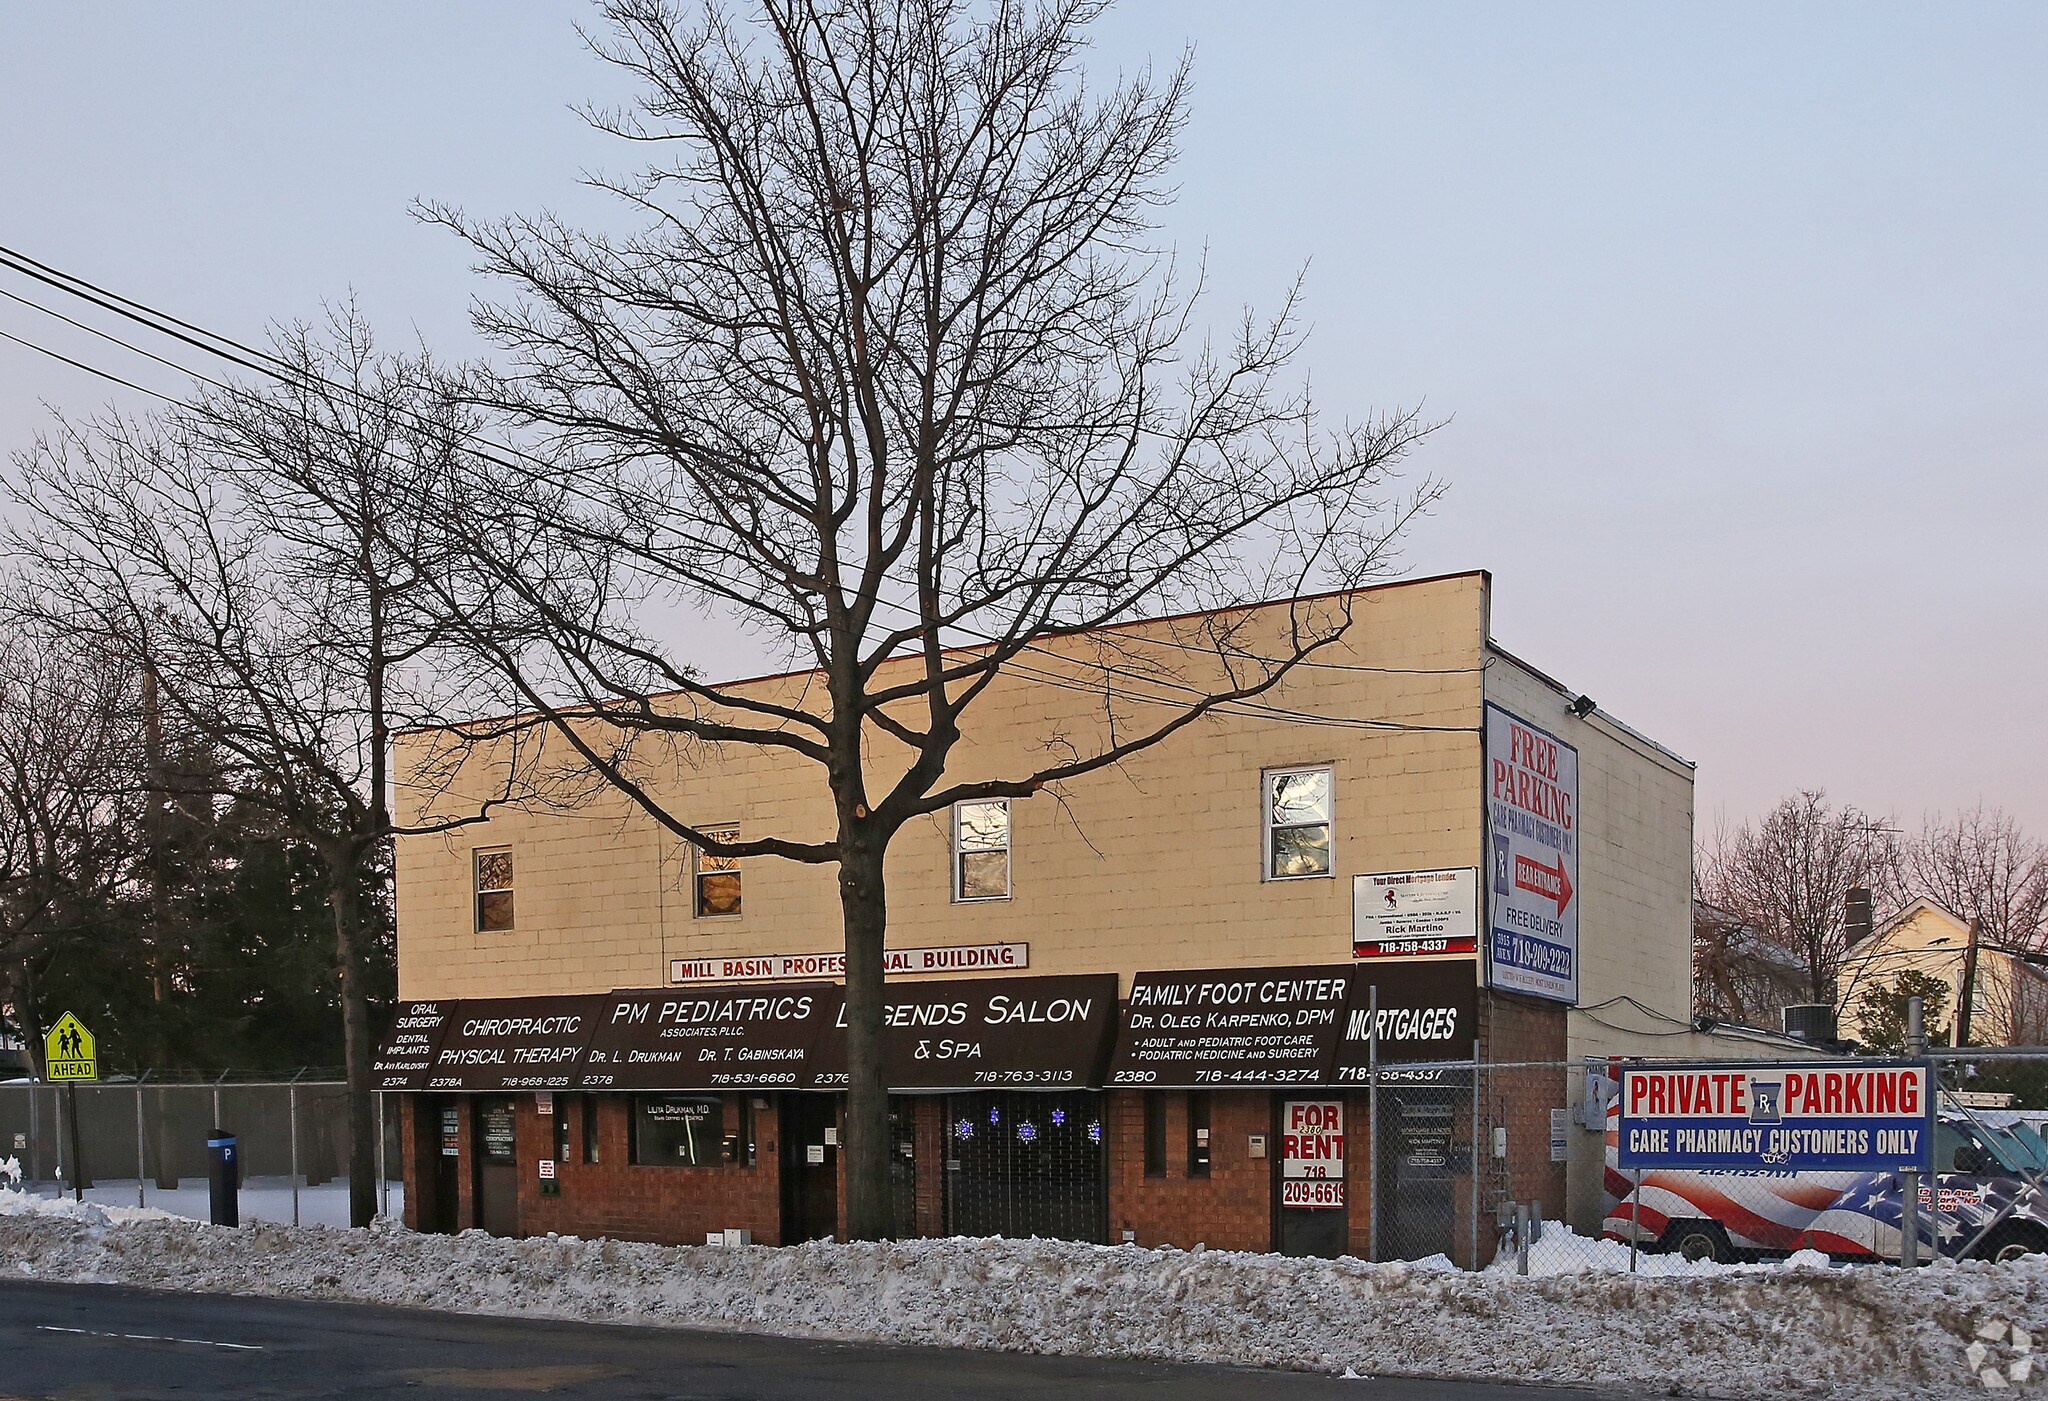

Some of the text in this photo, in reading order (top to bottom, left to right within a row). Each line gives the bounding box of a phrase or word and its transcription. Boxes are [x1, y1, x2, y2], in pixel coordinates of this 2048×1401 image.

[1510, 723, 1558, 783] FREE
[1492, 758, 1572, 830] PARKING
[1373, 877, 1386, 886] Your
[1387, 876, 1405, 884] Direct
[1406, 875, 1434, 884] Mortgage
[1518, 862, 1560, 895] REAR ENTRANCE
[1386, 924, 1444, 934] Rick Martino
[1506, 907, 1564, 938] FREE DELIVERY
[1378, 940, 1448, 953] 718-758-4337
[681, 947, 1014, 978] MILL BASIN PROFESNAL BUILDING
[1512, 937, 1570, 976] 718-209-2222
[1130, 978, 1346, 1006] FAMILY FOOT CENTER
[410, 1004, 438, 1014] ORAL
[612, 996, 812, 1024] PM PEDIATRICS
[836, 995, 1092, 1028] LGENDS SALON
[396, 1016, 443, 1029] SURGERY
[1130, 1008, 1334, 1029] DR. OLEG KARPENKO, DPM
[1346, 1007, 1458, 1040] MORTGAGES
[463, 1016, 582, 1036] CHIROPRACTIC
[660, 1027, 717, 1038] ASSOCIATES,
[396, 1034, 428, 1044] DENTAL
[1142, 1035, 1314, 1048] ADULT AND PEDIATRIC FOOT CARE
[386, 1046, 430, 1054] IMPLANTS
[438, 1046, 582, 1064] PHYSICAL THERAPY
[588, 1050, 682, 1063] DR. L. DRUKMAN
[698, 1048, 804, 1062] DR. T. GABINSKAYA
[914, 1040, 982, 1060] & SPA
[1138, 1048, 1320, 1061] PODIATRIC MEDICINE AND SURGERY
[53, 1062, 91, 1076] AHEAD
[974, 1070, 1072, 1082] 718-763-3113
[1114, 1070, 1320, 1082] 2380 718-444-3274
[1338, 1066, 1443, 1080] 718-58-4337
[382, 1077, 408, 1086] 2374
[430, 1076, 569, 1087] 2378A 718-968-1225
[582, 1073, 796, 1085] 2378 718-531-6660
[1632, 1072, 1918, 1114] PRIVATE PARKING
[1292, 1105, 1338, 1130] FOR
[1300, 1126, 1322, 1134] 2380
[1284, 1135, 1344, 1159] RENT
[1629, 1128, 1919, 1154] CARE PHARMACY CUSTOMERS ONLY
[224, 1148, 232, 1160] P
[1304, 1166, 1326, 1178] 718
